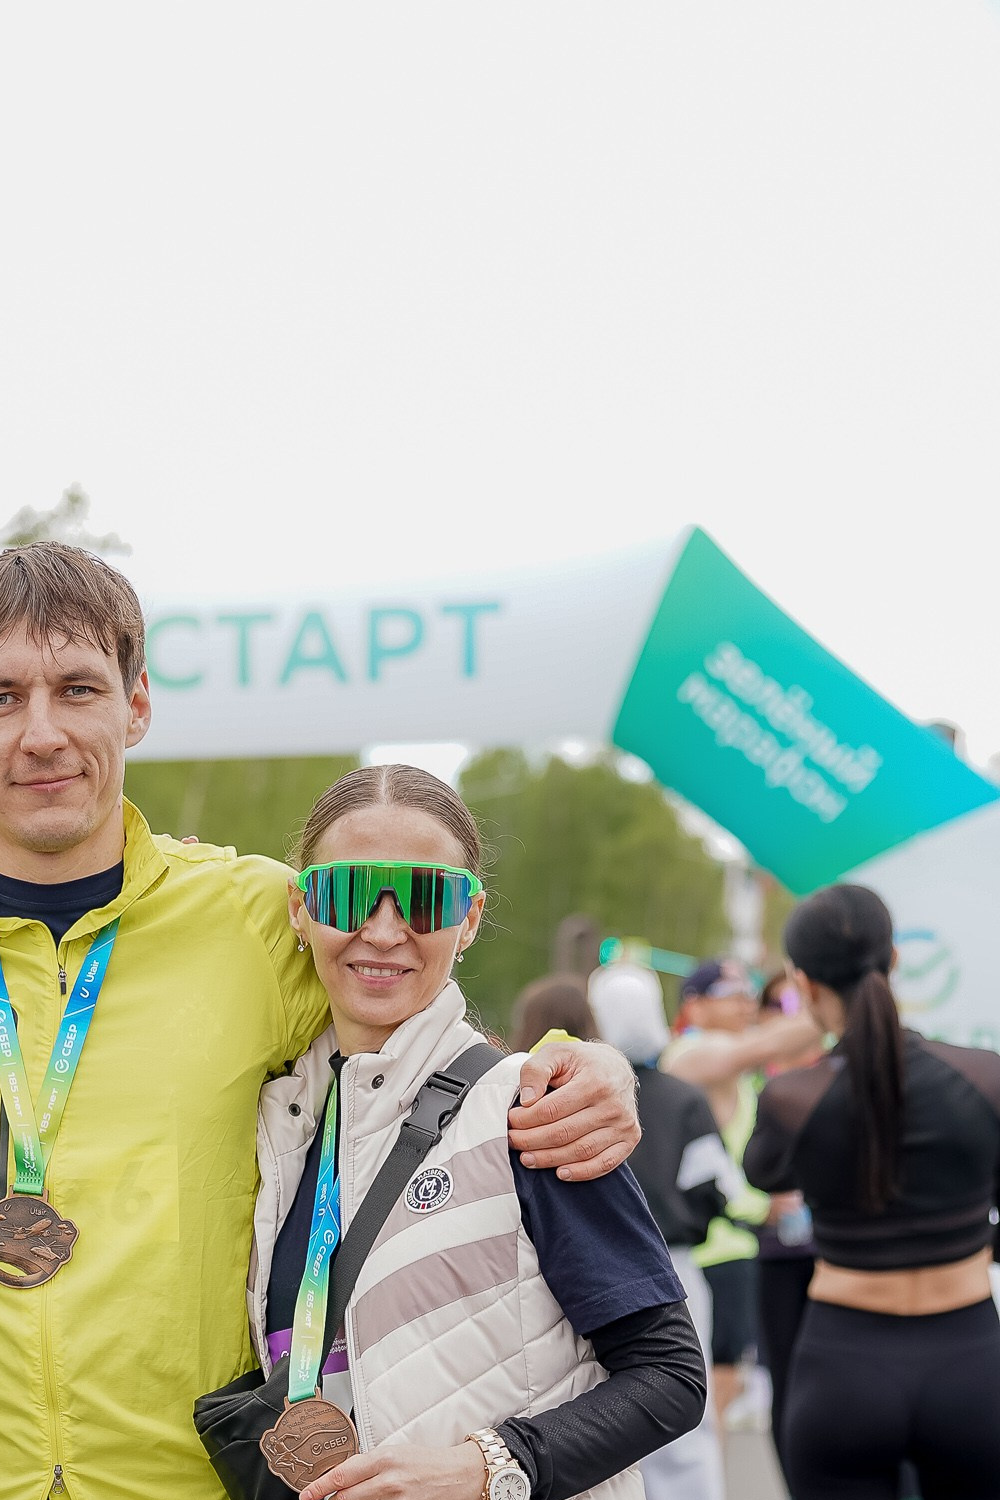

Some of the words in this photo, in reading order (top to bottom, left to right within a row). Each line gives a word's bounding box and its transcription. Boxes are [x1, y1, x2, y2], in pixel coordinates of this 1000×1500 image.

[144, 602, 499, 689] СТАРТ
[84, 960, 99, 983] Utair
[62, 1024, 78, 1057] СБЕР
[8, 1071, 19, 1093] 185
[47, 1087, 58, 1110] лет
[40, 1112, 51, 1133] 185
[29, 1207, 47, 1216] Utair
[313, 1245, 327, 1277] СБЕР
[306, 1289, 315, 1309] 185
[323, 1435, 348, 1450] СБЕР
